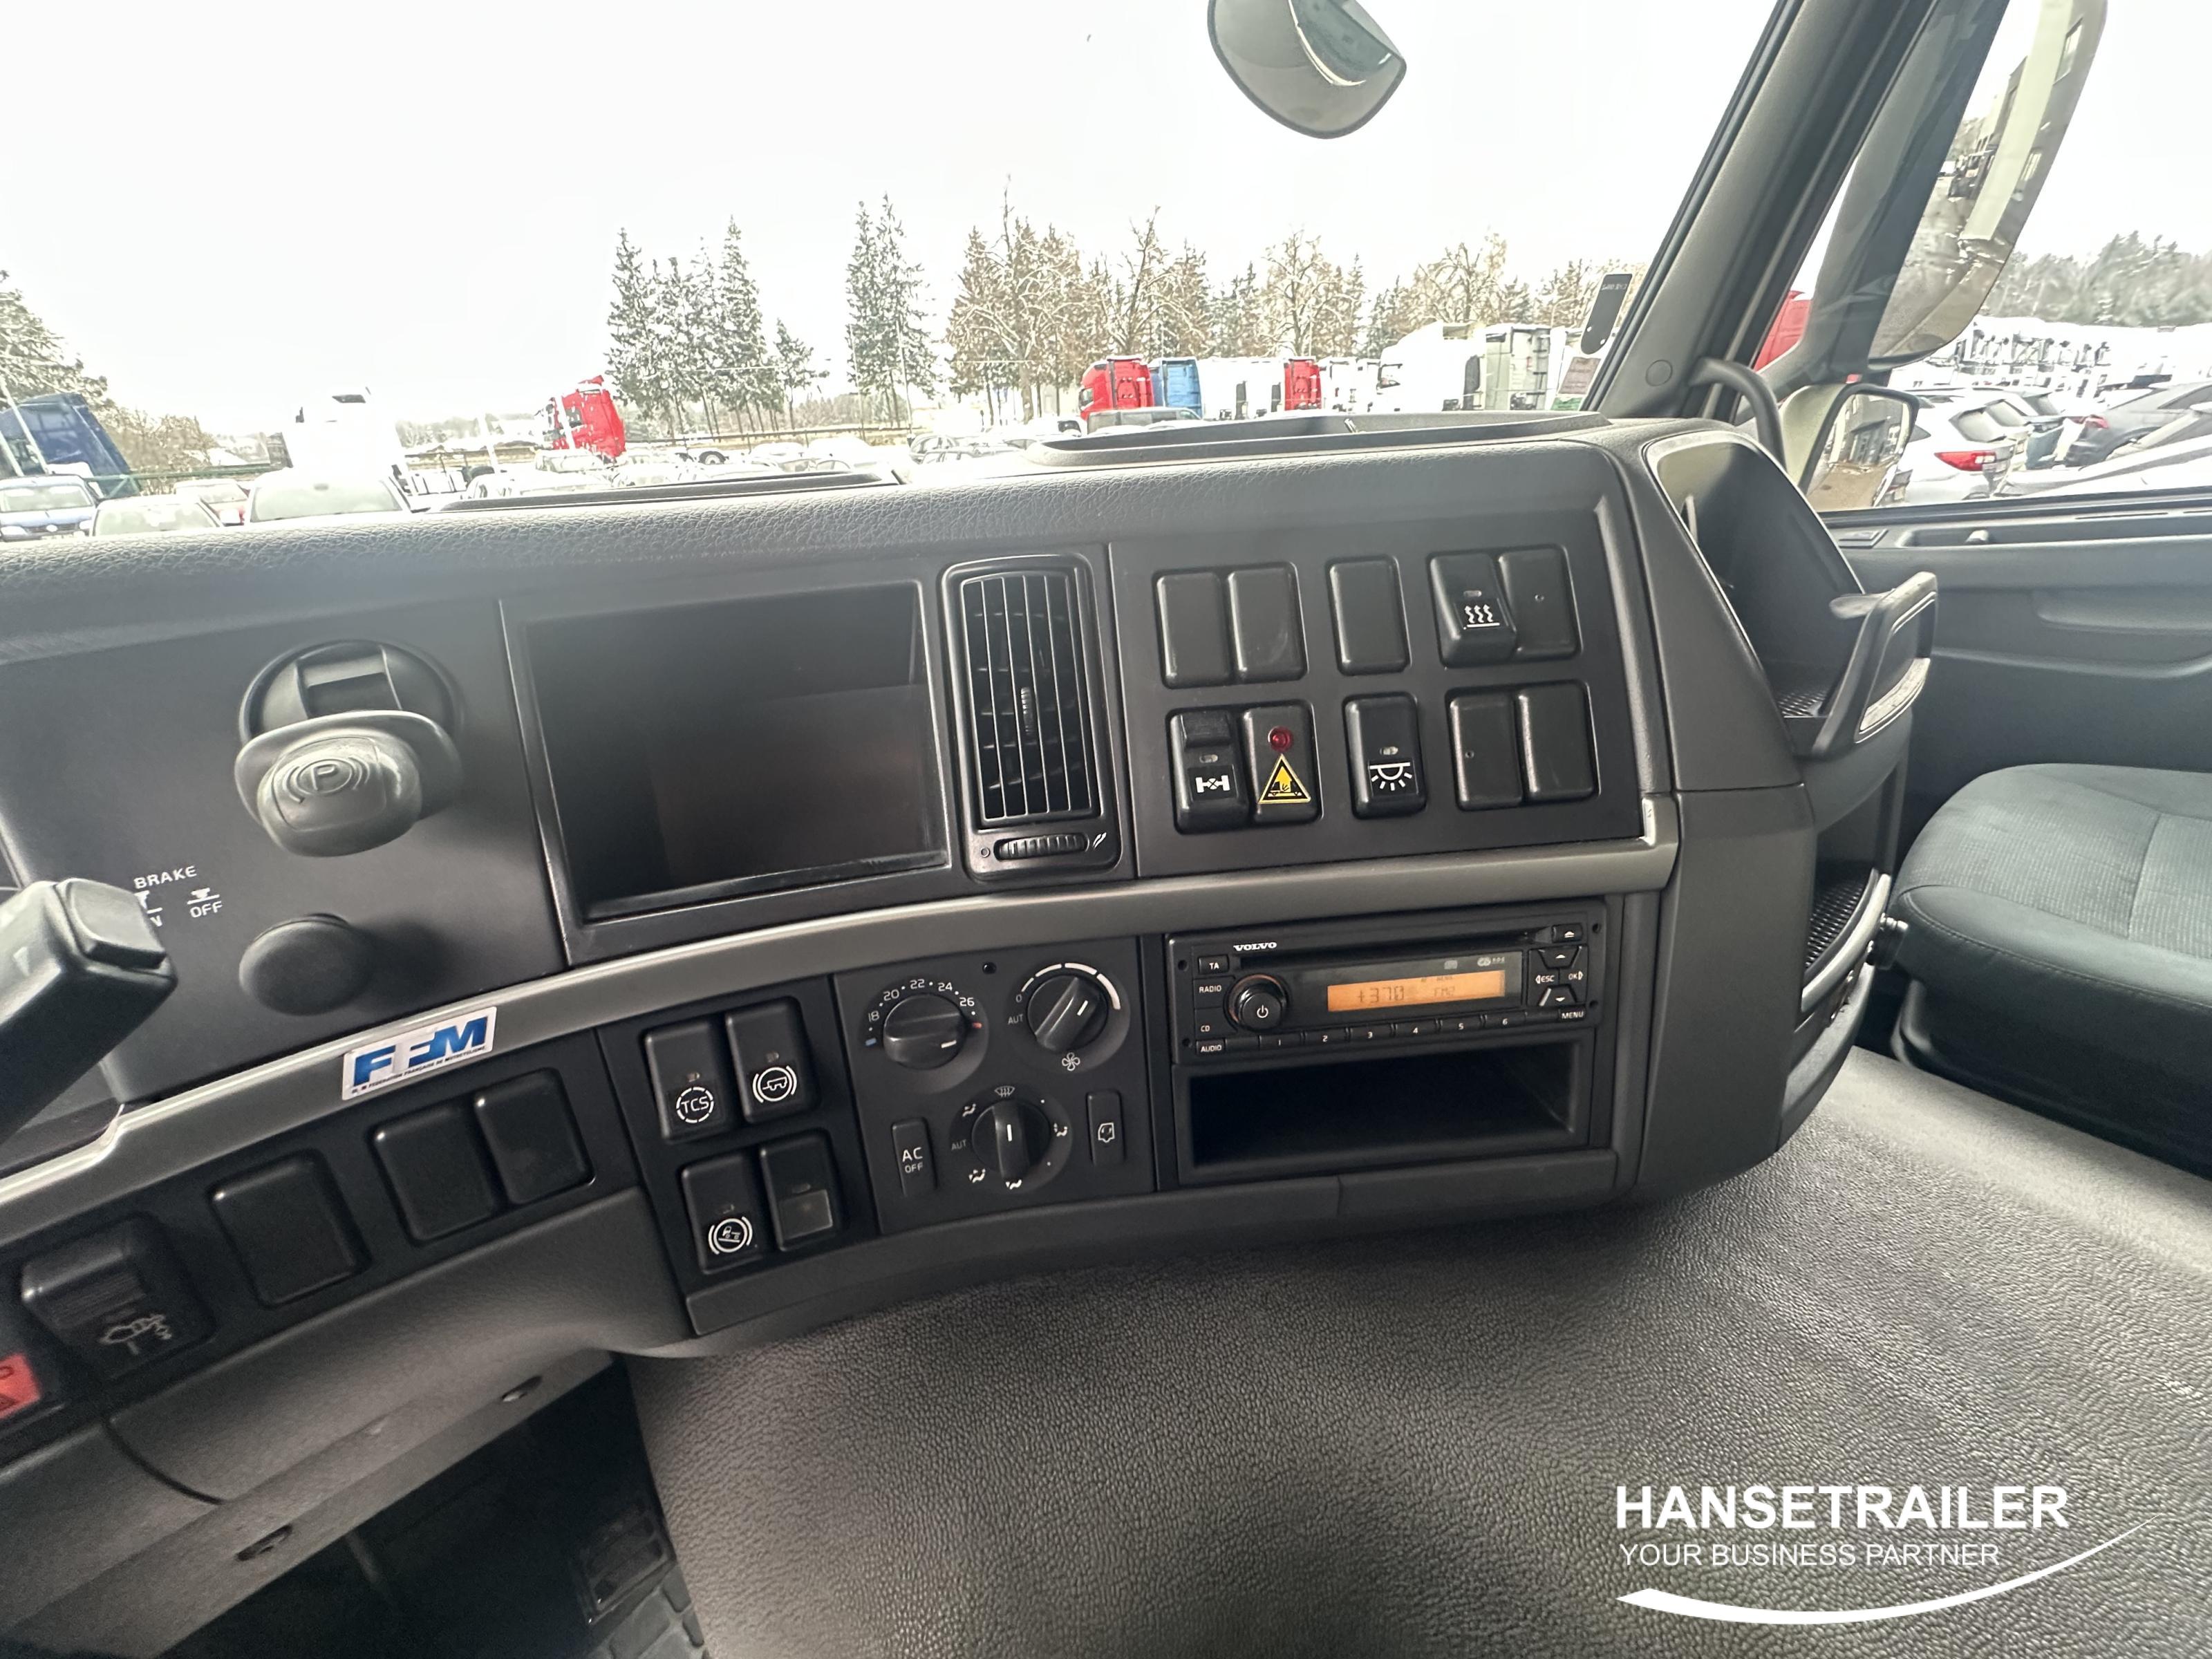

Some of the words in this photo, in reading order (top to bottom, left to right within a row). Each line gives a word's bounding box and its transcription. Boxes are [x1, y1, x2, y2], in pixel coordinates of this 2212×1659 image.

[133, 865, 197, 889] BRAKE
[190, 901, 223, 918] OFF
[1233, 942, 1277, 952] VOLVO
[910, 979, 925, 989] 22
[938, 982, 953, 991] 24
[1199, 985, 1222, 993] RADIO
[883, 989, 899, 1001] 20
[959, 997, 975, 1006] 26
[868, 1011, 880, 1022] 18
[1008, 1013, 1023, 1024] AUT
[1562, 1011, 1584, 1019] MENU
[681, 1096, 709, 1114] TCS
[951, 1139, 966, 1151] AUT
[902, 1147, 923, 1162] AC
[904, 1162, 923, 1173] OFF
